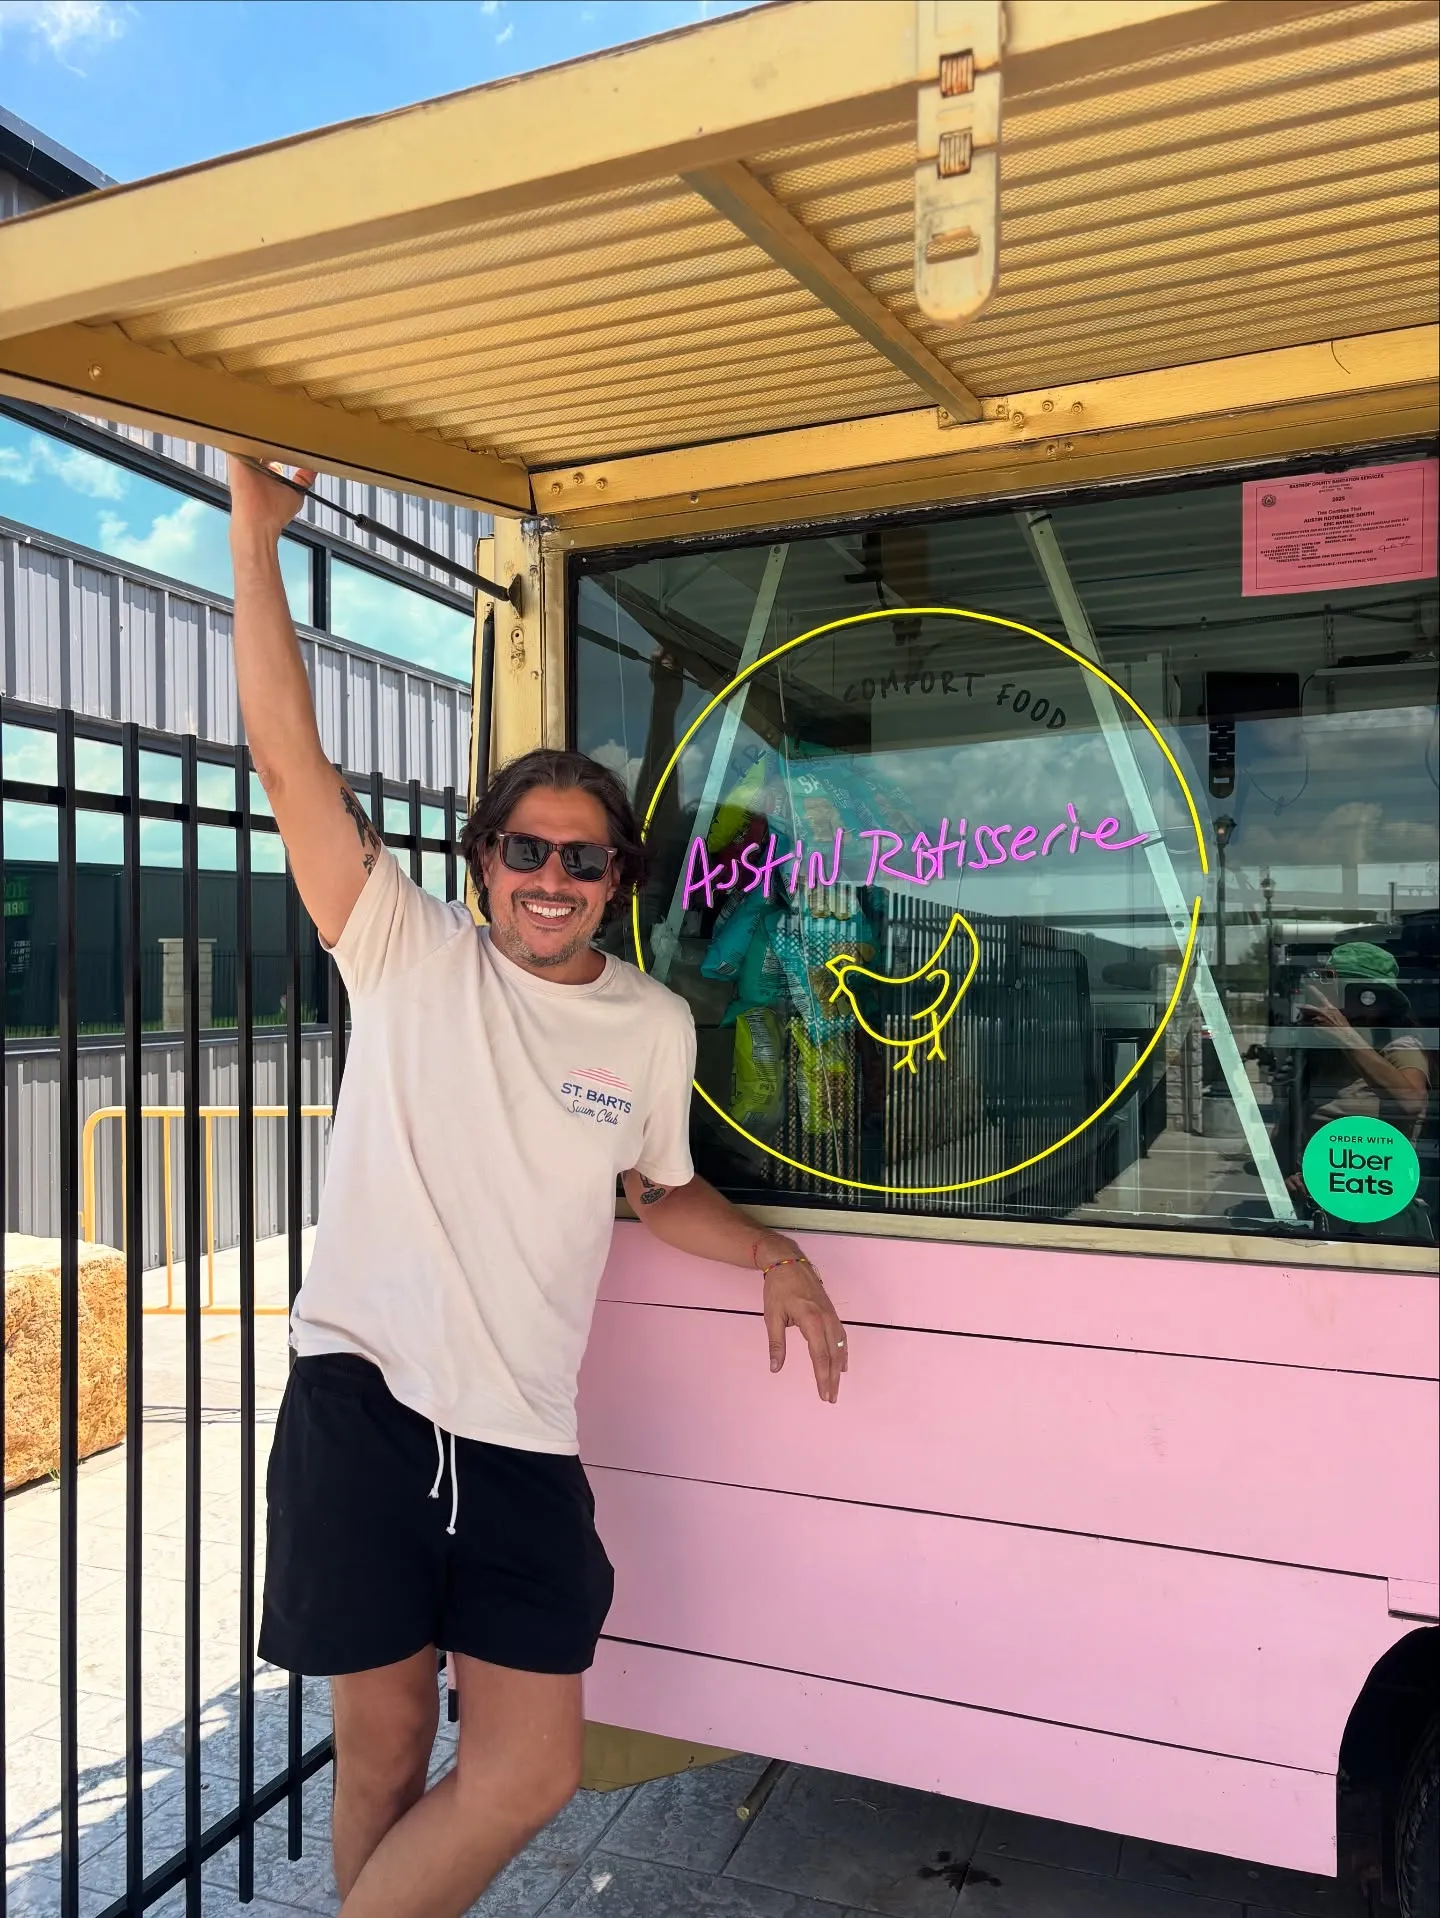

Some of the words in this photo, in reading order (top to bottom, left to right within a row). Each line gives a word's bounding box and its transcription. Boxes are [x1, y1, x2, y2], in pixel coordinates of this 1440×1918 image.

[1355, 510, 1375, 518] SOUTH
[843, 668, 986, 703] COMFORT
[996, 683, 1067, 730] FOOD
[561, 1082, 583, 1098] ST.
[586, 1089, 632, 1114] BARTS
[566, 1099, 596, 1118] Swim
[596, 1108, 619, 1126] Club
[1329, 1135, 1363, 1143] ORDER
[1366, 1136, 1394, 1145] WITH
[1329, 1147, 1393, 1171] Uber
[1329, 1172, 1394, 1196] Eats
